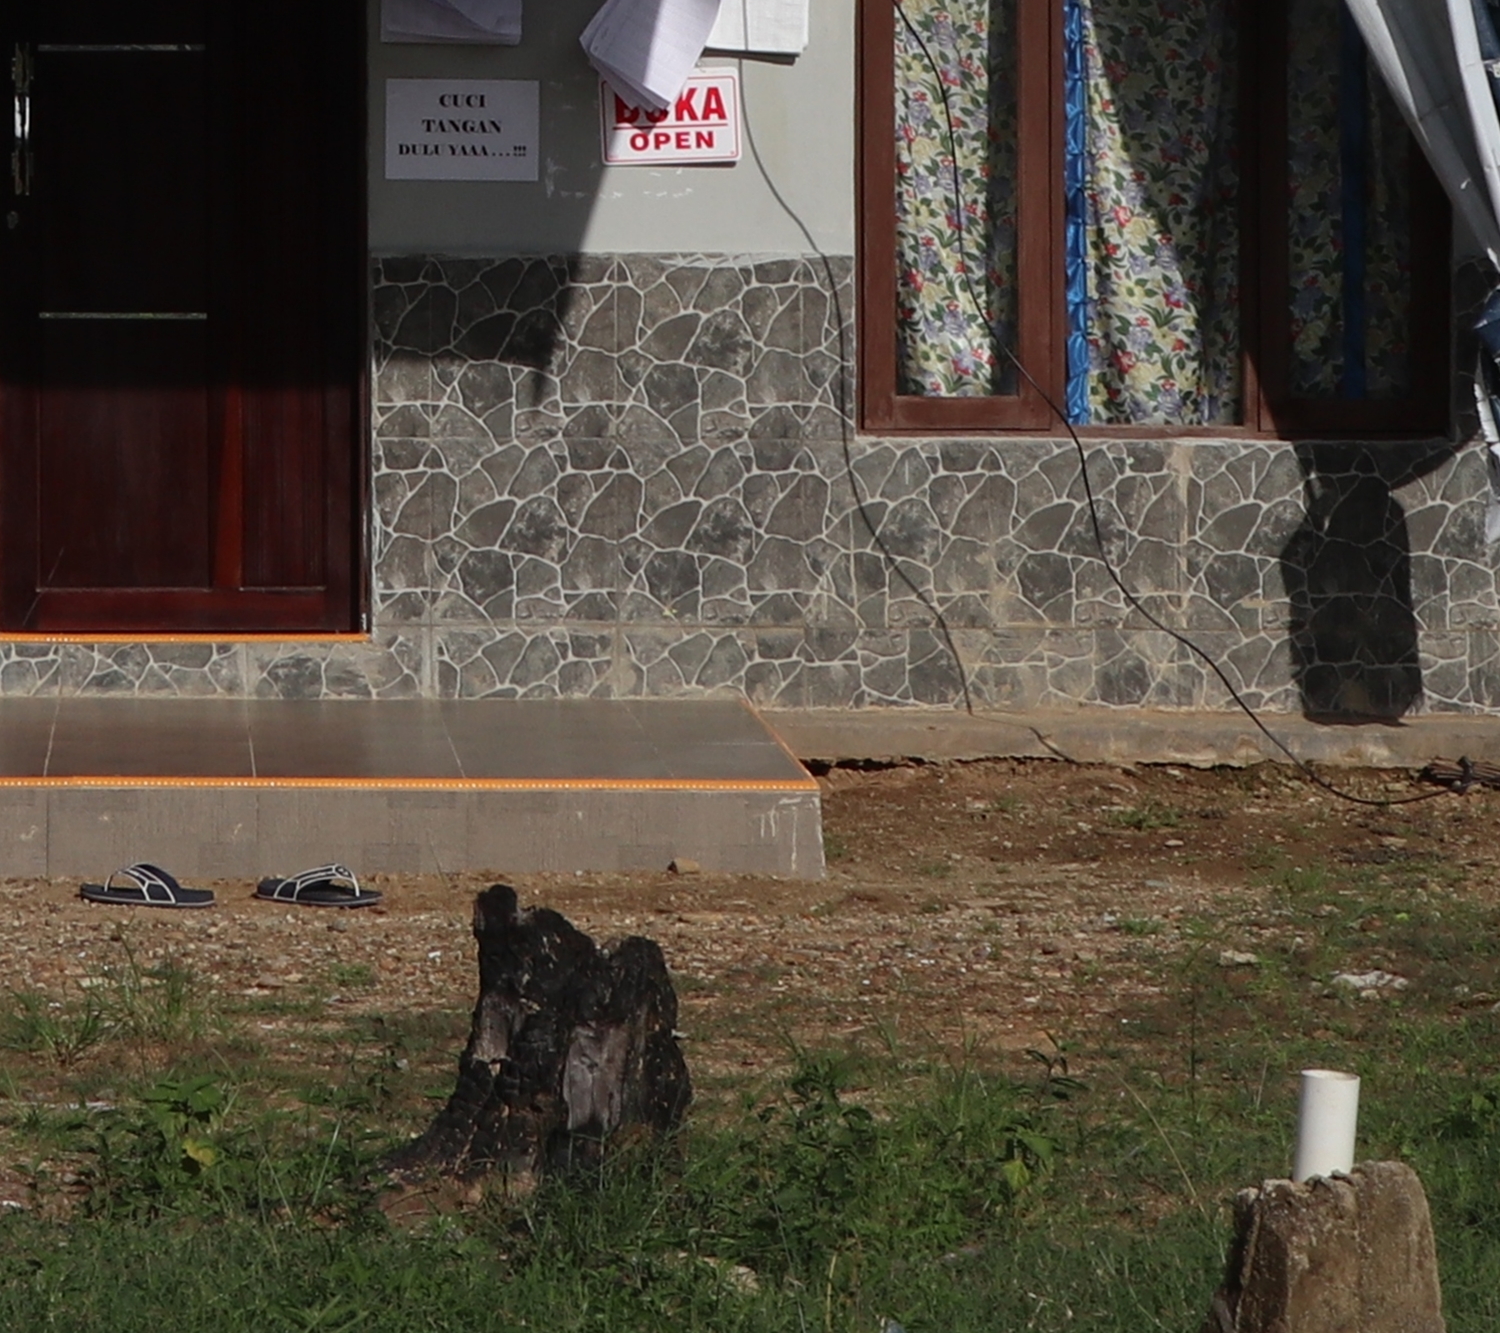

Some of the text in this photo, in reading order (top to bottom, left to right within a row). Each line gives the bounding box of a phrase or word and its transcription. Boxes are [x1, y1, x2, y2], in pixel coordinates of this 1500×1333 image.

[439, 94, 486, 108] CUCI
[422, 119, 502, 134] TANGAN
[630, 130, 715, 151] OPEN
[398, 143, 444, 156] DULU
